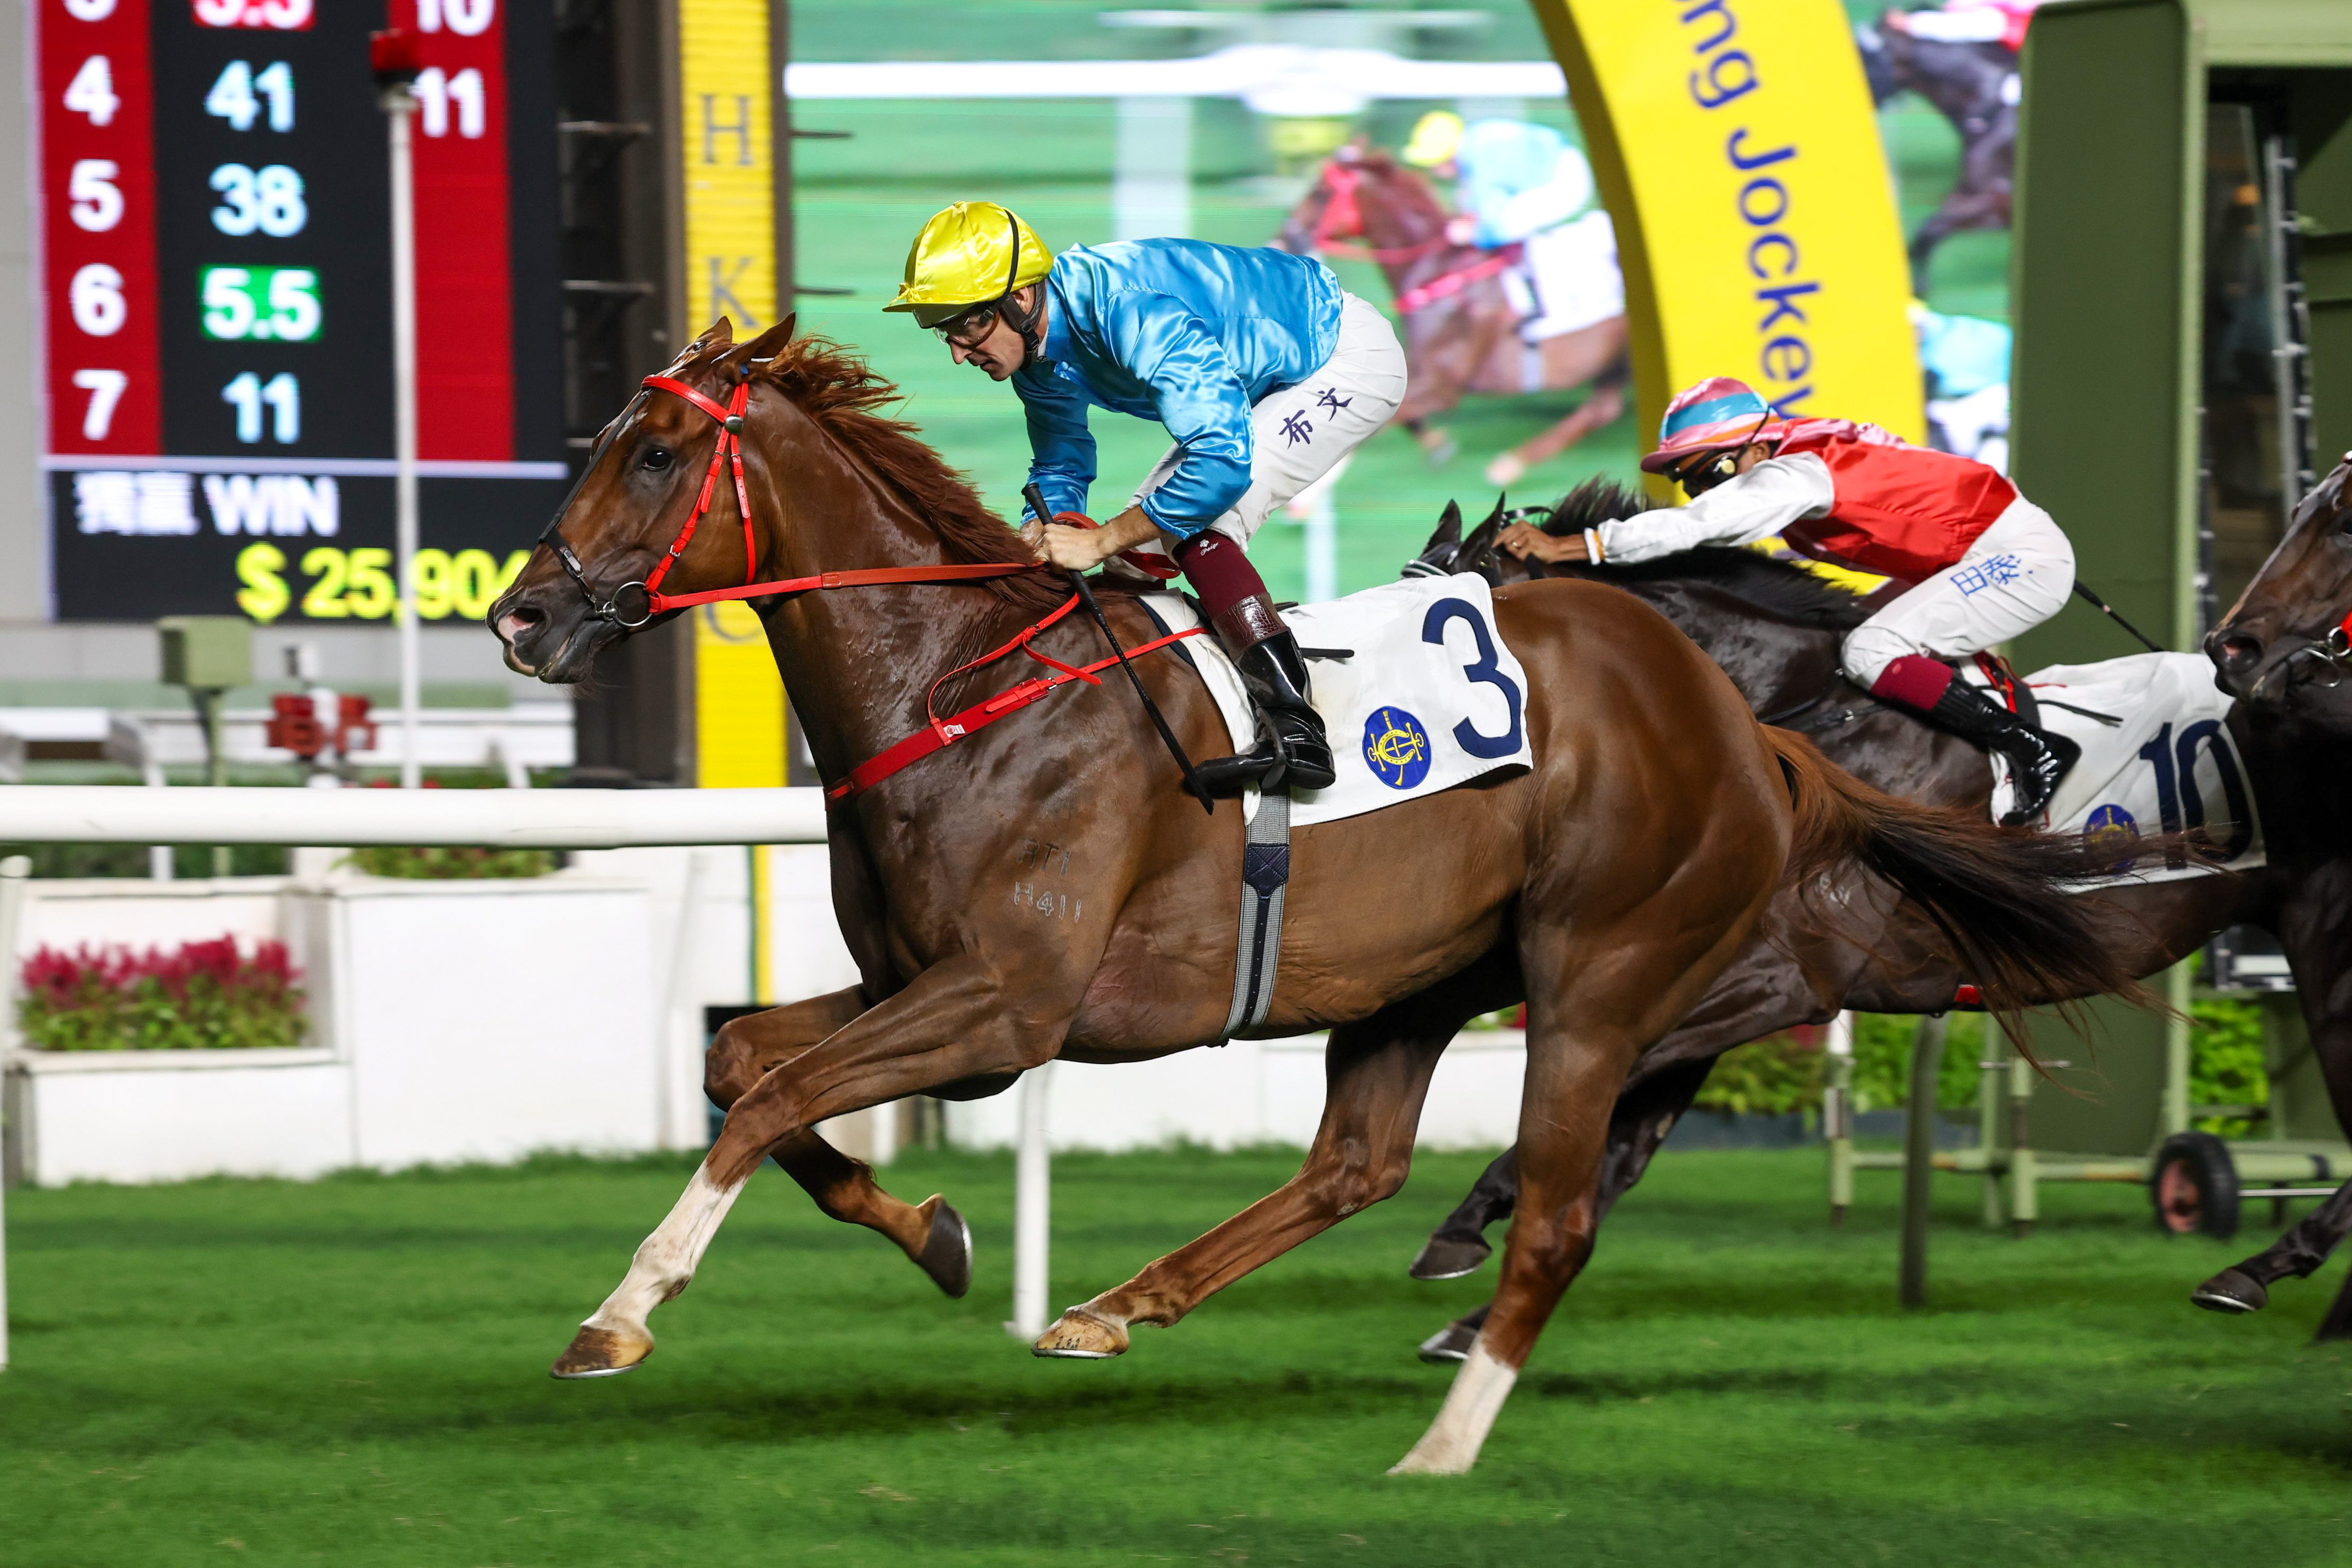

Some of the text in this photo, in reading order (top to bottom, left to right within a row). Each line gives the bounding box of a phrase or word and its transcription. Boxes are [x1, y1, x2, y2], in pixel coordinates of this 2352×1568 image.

[63, 56, 119, 125] 4
[204, 60, 295, 132] 41
[407, 67, 485, 138] 11
[70, 160, 124, 232] 5
[209, 164, 308, 237] 38
[71, 264, 126, 336] 6
[203, 269, 321, 340] 5.5
[72, 369, 127, 440] 7
[222, 373, 300, 443] 11
[1279, 387, 1353, 449] 布文
[202, 474, 339, 536] WIN
[1422, 597, 1522, 758] 3
[2140, 719, 2253, 869] 10
